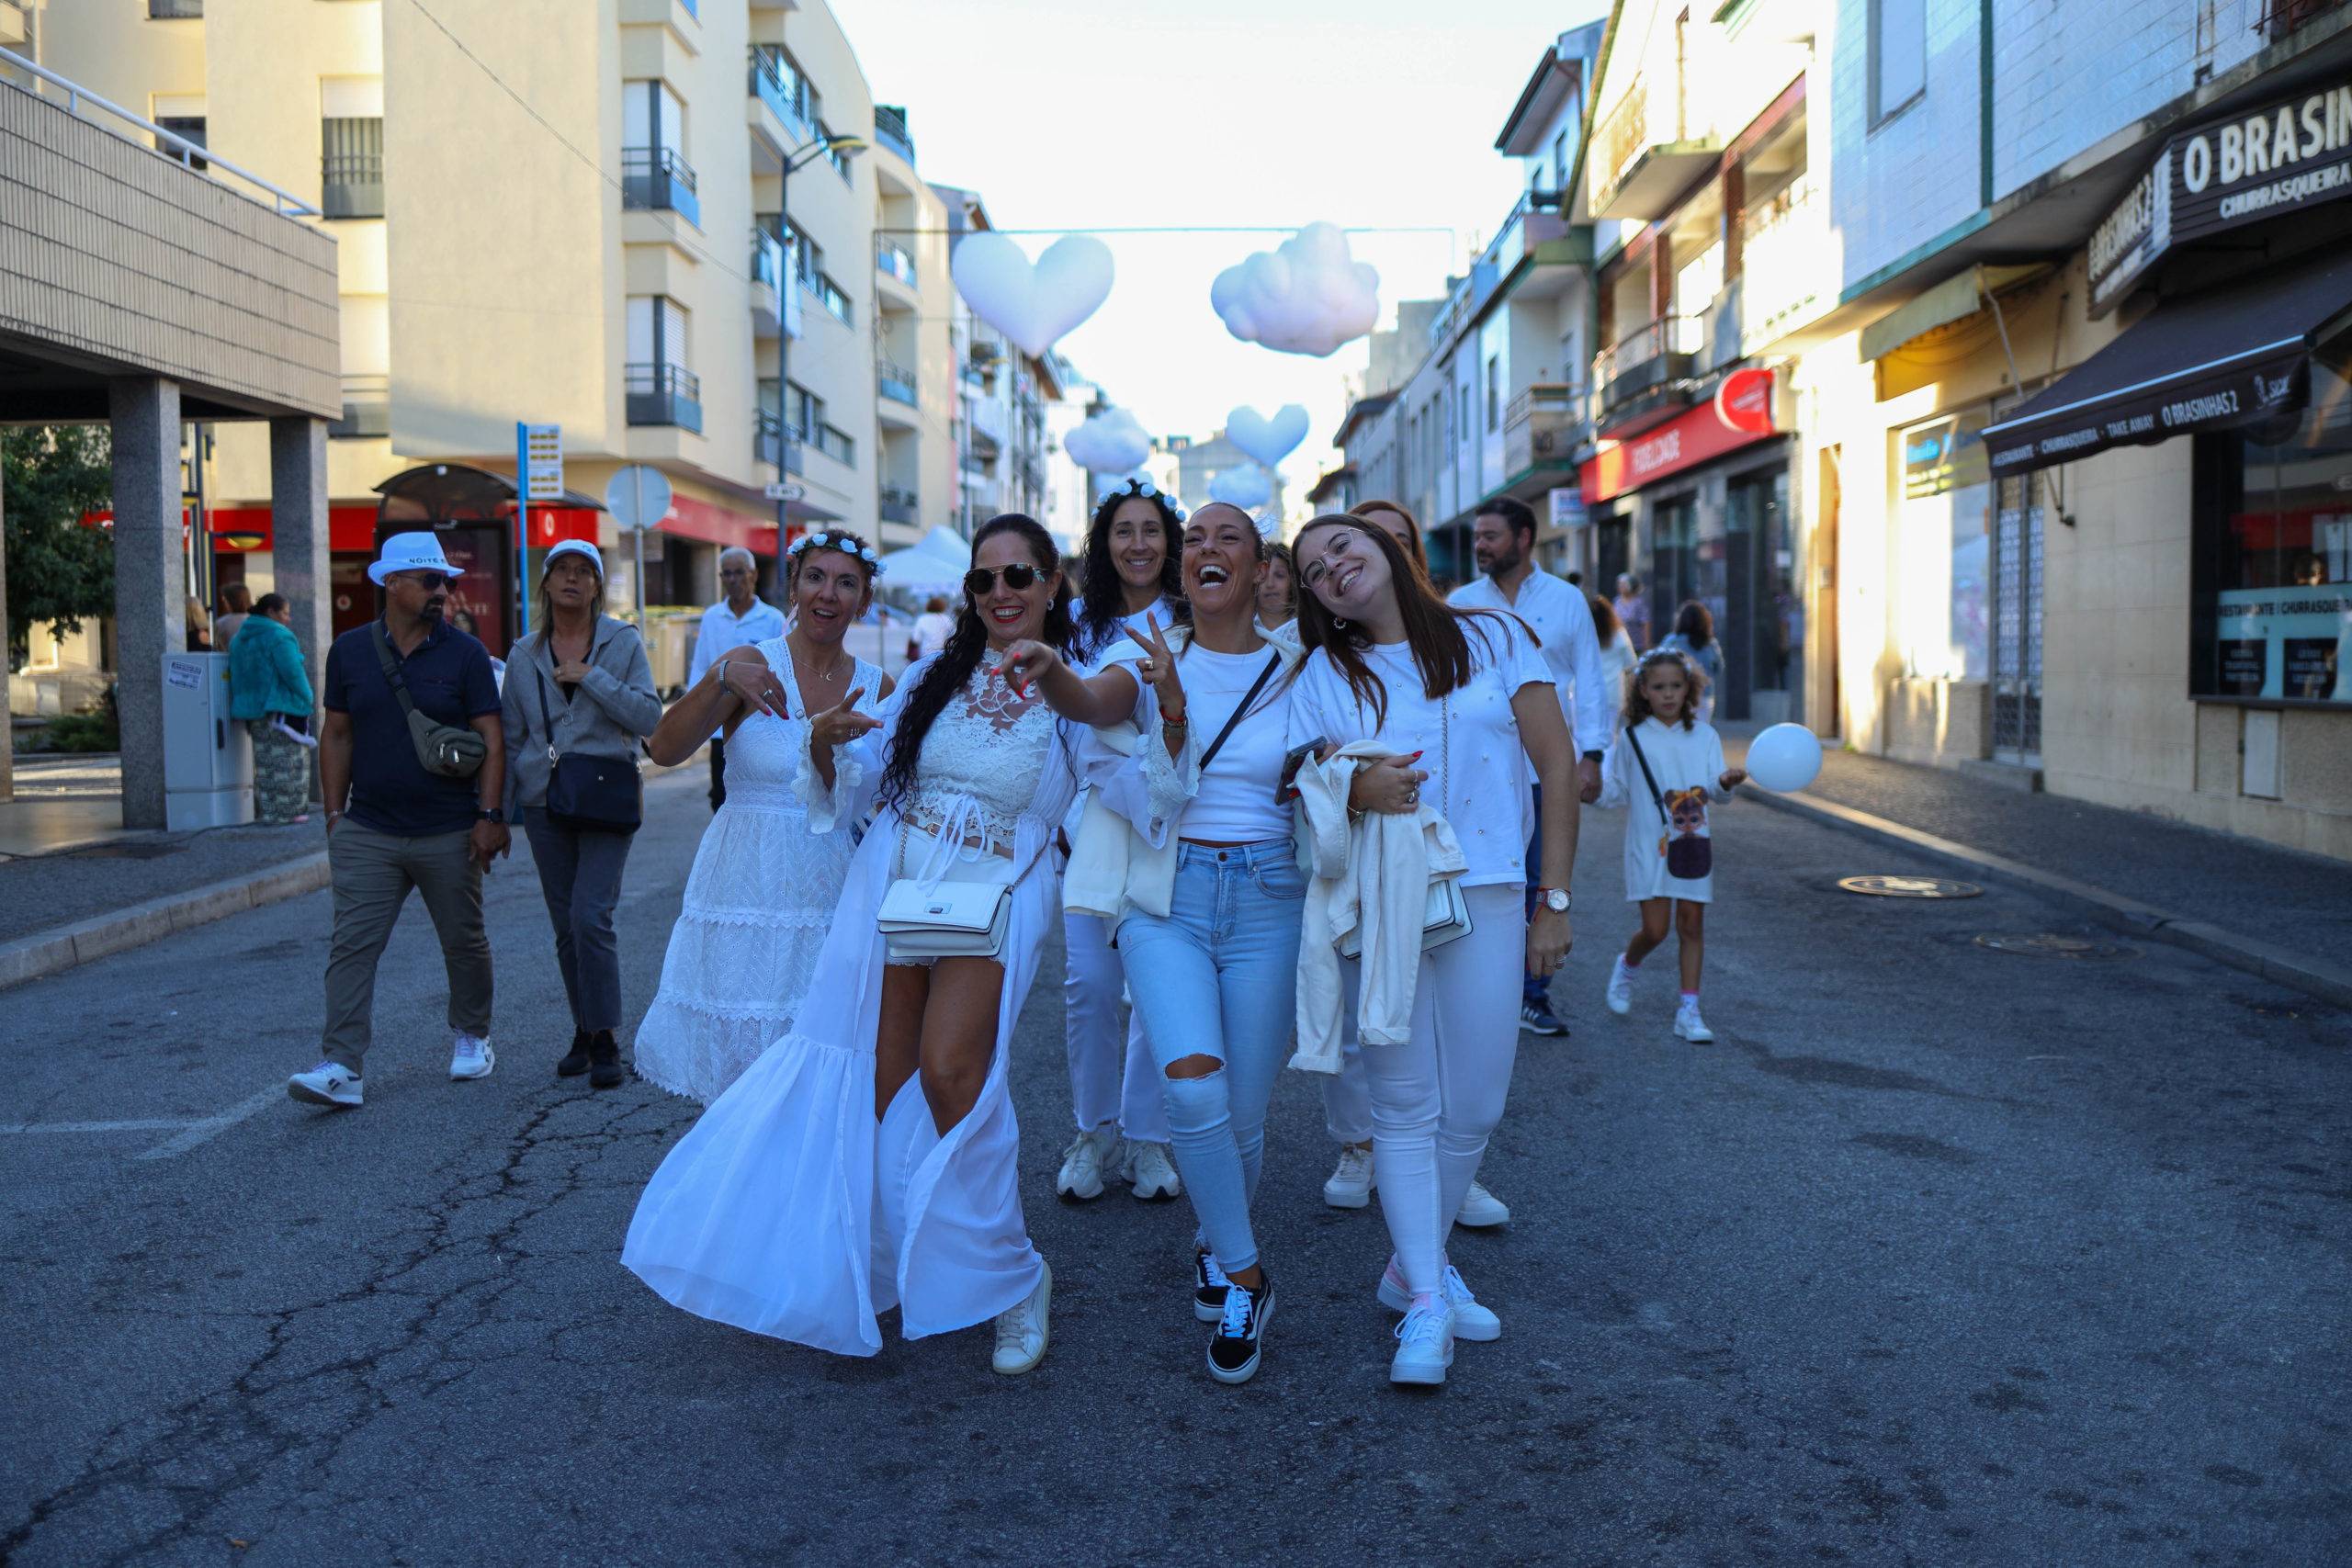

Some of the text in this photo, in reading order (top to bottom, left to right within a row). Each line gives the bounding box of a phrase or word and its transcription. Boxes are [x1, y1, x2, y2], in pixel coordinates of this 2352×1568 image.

[2183, 136, 2211, 193] O
[2220, 163, 2351, 219] CHURRASQUEIRA
[2106, 419, 2129, 438] TAKE
[2130, 413, 2154, 432] AWAY
[2162, 405, 2171, 427] O
[2171, 392, 2230, 425] BRASINHAS
[2230, 389, 2239, 412] 2
